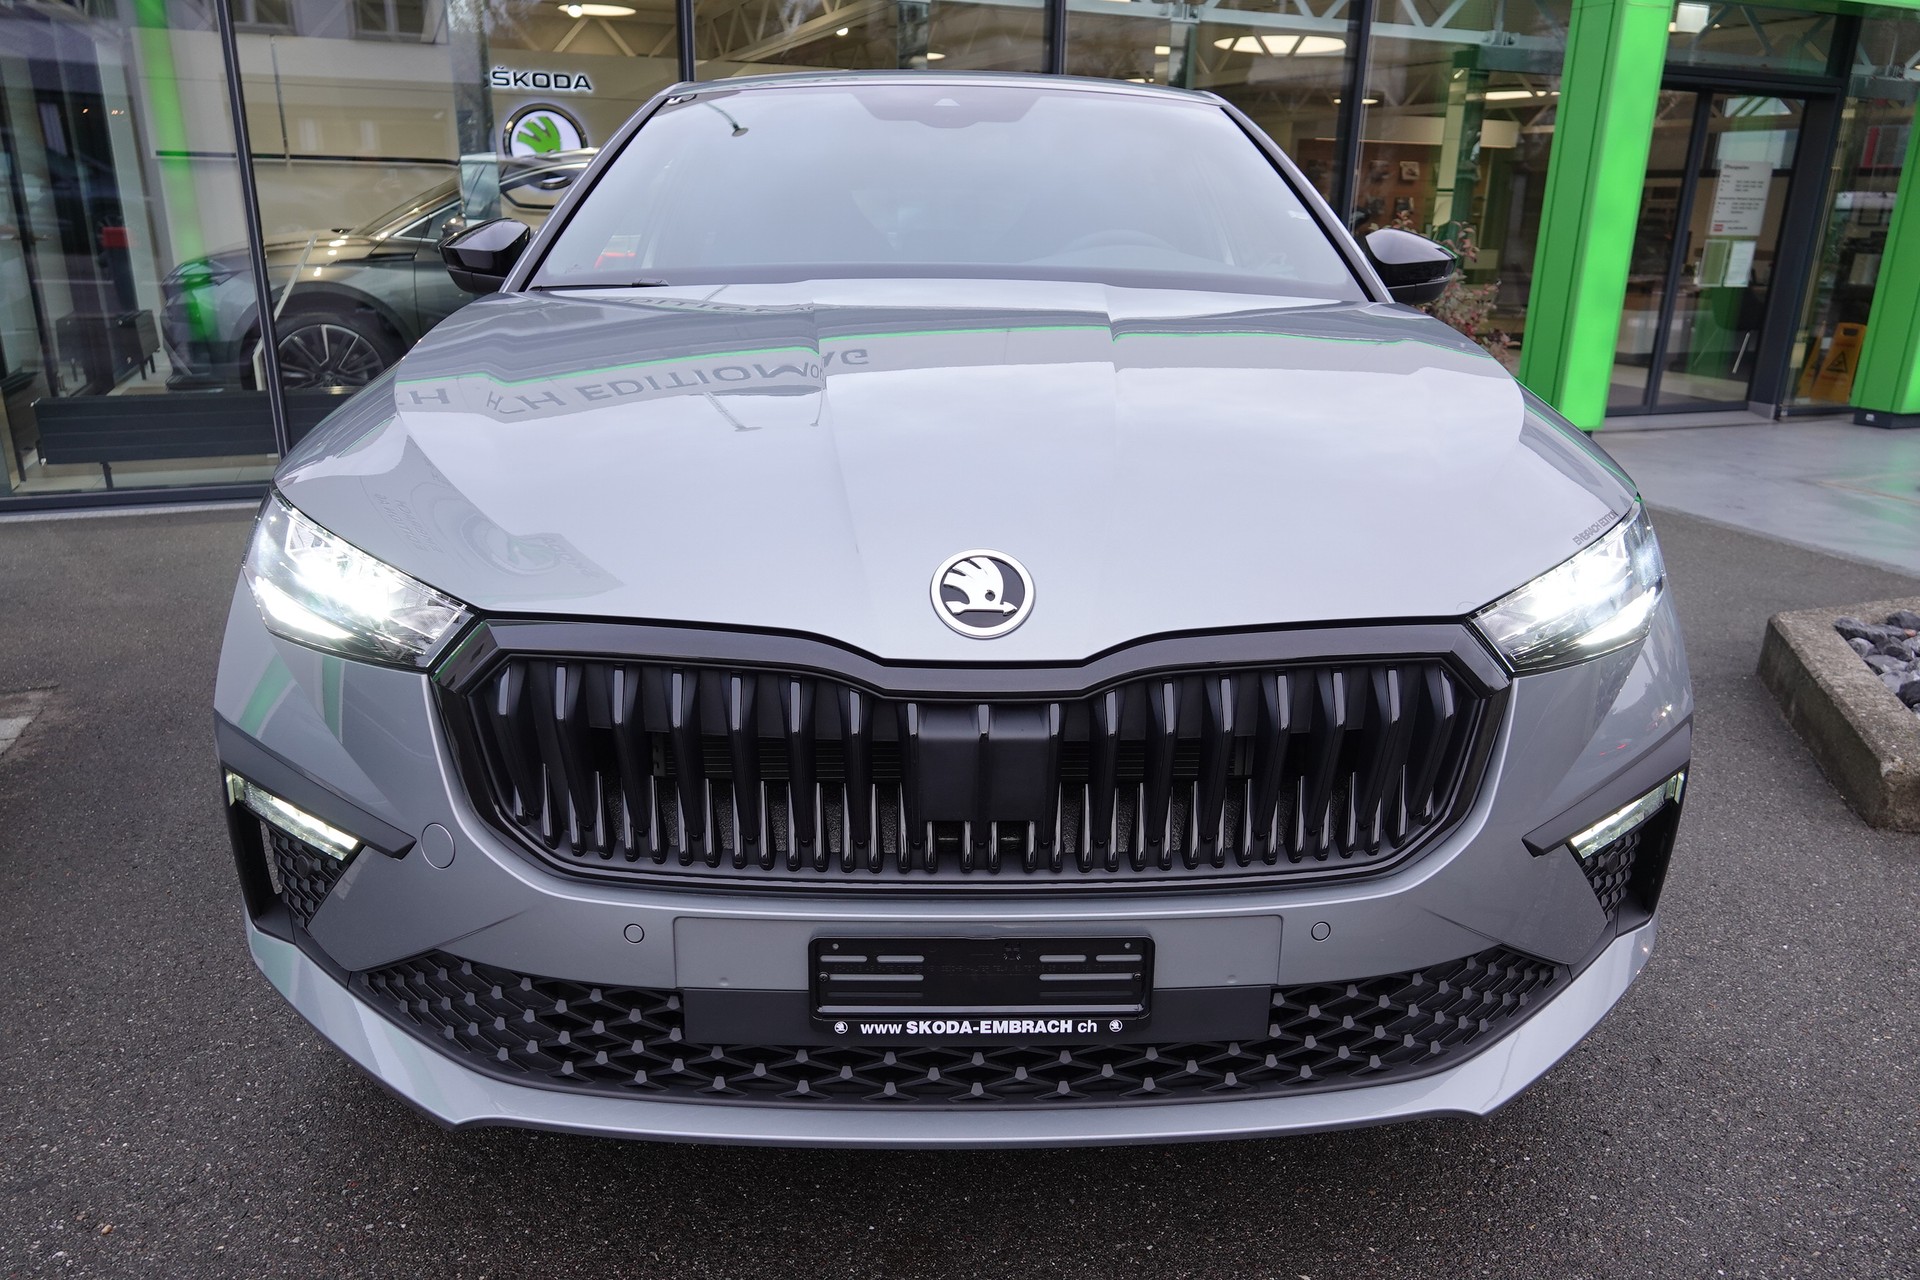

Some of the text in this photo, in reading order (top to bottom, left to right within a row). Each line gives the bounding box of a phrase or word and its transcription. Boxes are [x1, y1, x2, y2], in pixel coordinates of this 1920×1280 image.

[490, 65, 593, 91] ŠKODA
[860, 1020, 1098, 1035] www SKODA-EMBRACH ch
